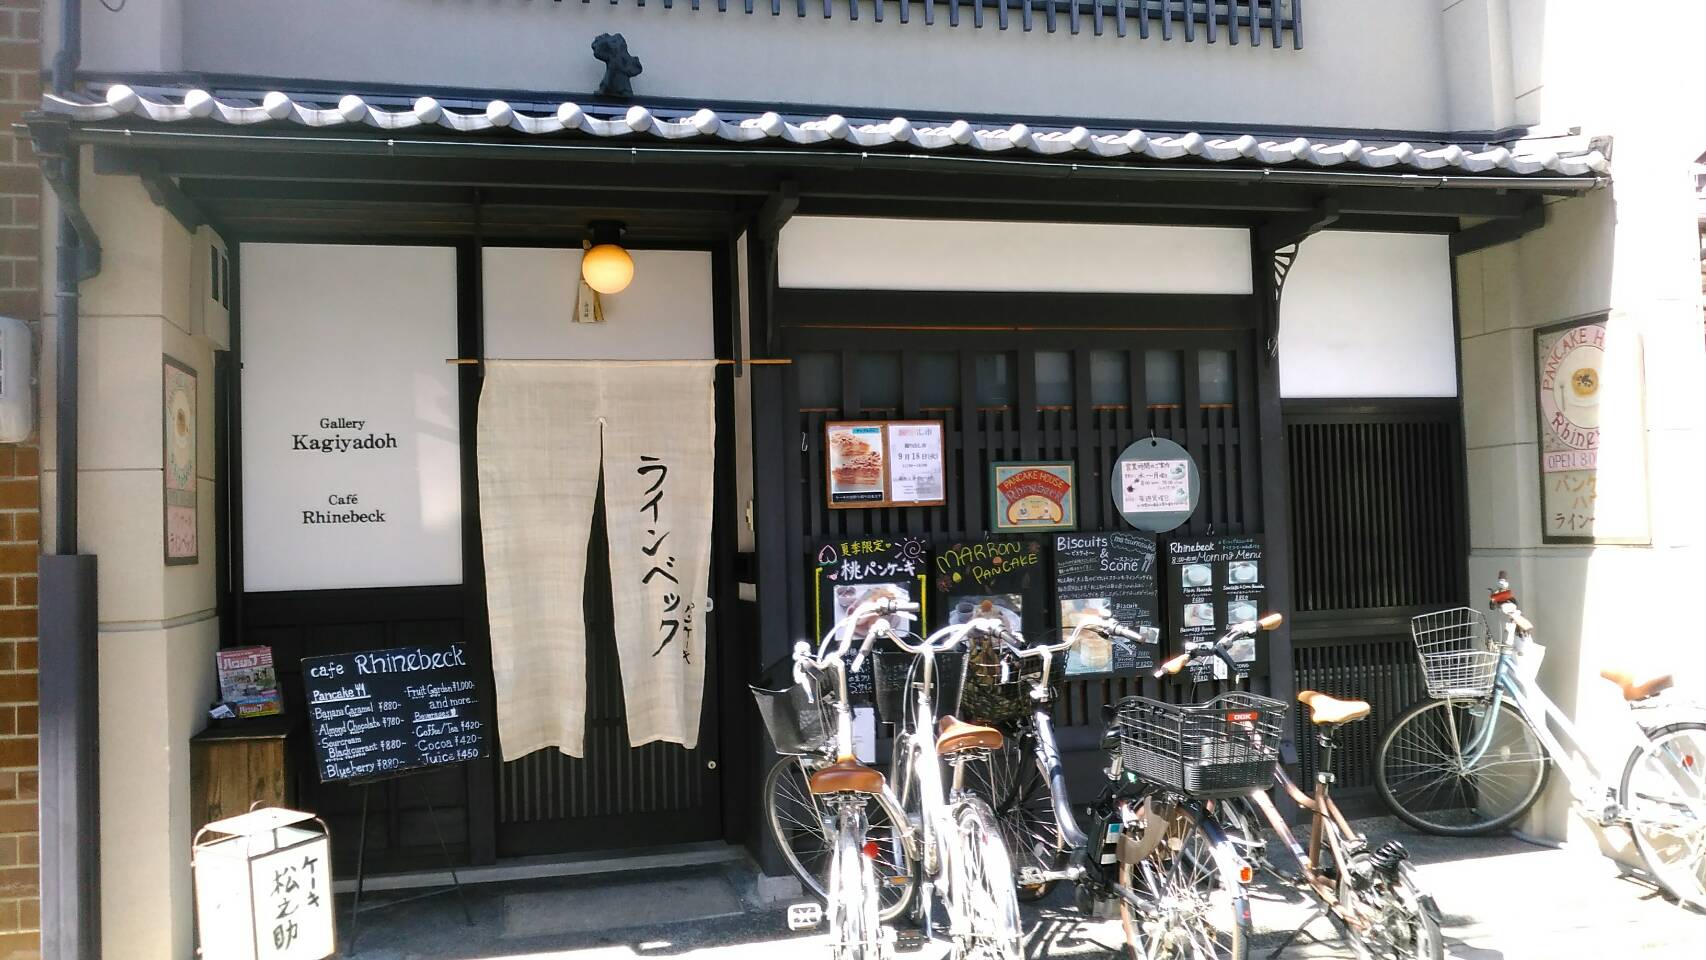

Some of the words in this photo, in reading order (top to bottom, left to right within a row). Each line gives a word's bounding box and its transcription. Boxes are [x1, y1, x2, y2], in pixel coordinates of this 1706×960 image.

[1543, 328, 1587, 391] PANCAKE
[320, 418, 365, 430] Gallery
[1552, 411, 1600, 449] Rhine
[292, 433, 397, 452] Kagiyadoh
[1548, 453, 1576, 468] OPEN
[1004, 470, 1038, 489] PANCAKE
[1040, 472, 1064, 489] HOUSE
[328, 494, 359, 505] Café
[302, 510, 386, 524] Rhinebeck
[840, 540, 886, 557] 夏季限定
[1057, 536, 1108, 551] Biscuits
[1170, 542, 1215, 554] Rhinebeck
[637, 455, 681, 658] ラインベック
[936, 541, 1021, 574] MARRON
[1100, 548, 1109, 559] &
[1197, 551, 1234, 563] Morning
[1235, 549, 1262, 560] Menu
[840, 559, 916, 581] 桃パンケーキ
[972, 553, 1038, 585] PANCAKE
[1100, 559, 1138, 572] Scone
[682, 602, 695, 664] パンケーキ
[311, 662, 345, 679] cafe
[354, 644, 467, 675] Rhinebeck
[312, 687, 355, 702] Pancake
[406, 685, 427, 697] Fruit
[427, 682, 453, 696] Garden
[314, 706, 344, 720] Banana
[344, 702, 373, 716] Caramel
[429, 696, 449, 710] and
[318, 721, 347, 736] Almond
[346, 716, 381, 733] Chocolate
[328, 742, 378, 760] Blackcurrant
[417, 740, 454, 751] Cocoa
[421, 752, 455, 765] Juice
[326, 761, 375, 778] Blueberry
[302, 856, 319, 907] ケーキ
[270, 866, 300, 950] 松之助
